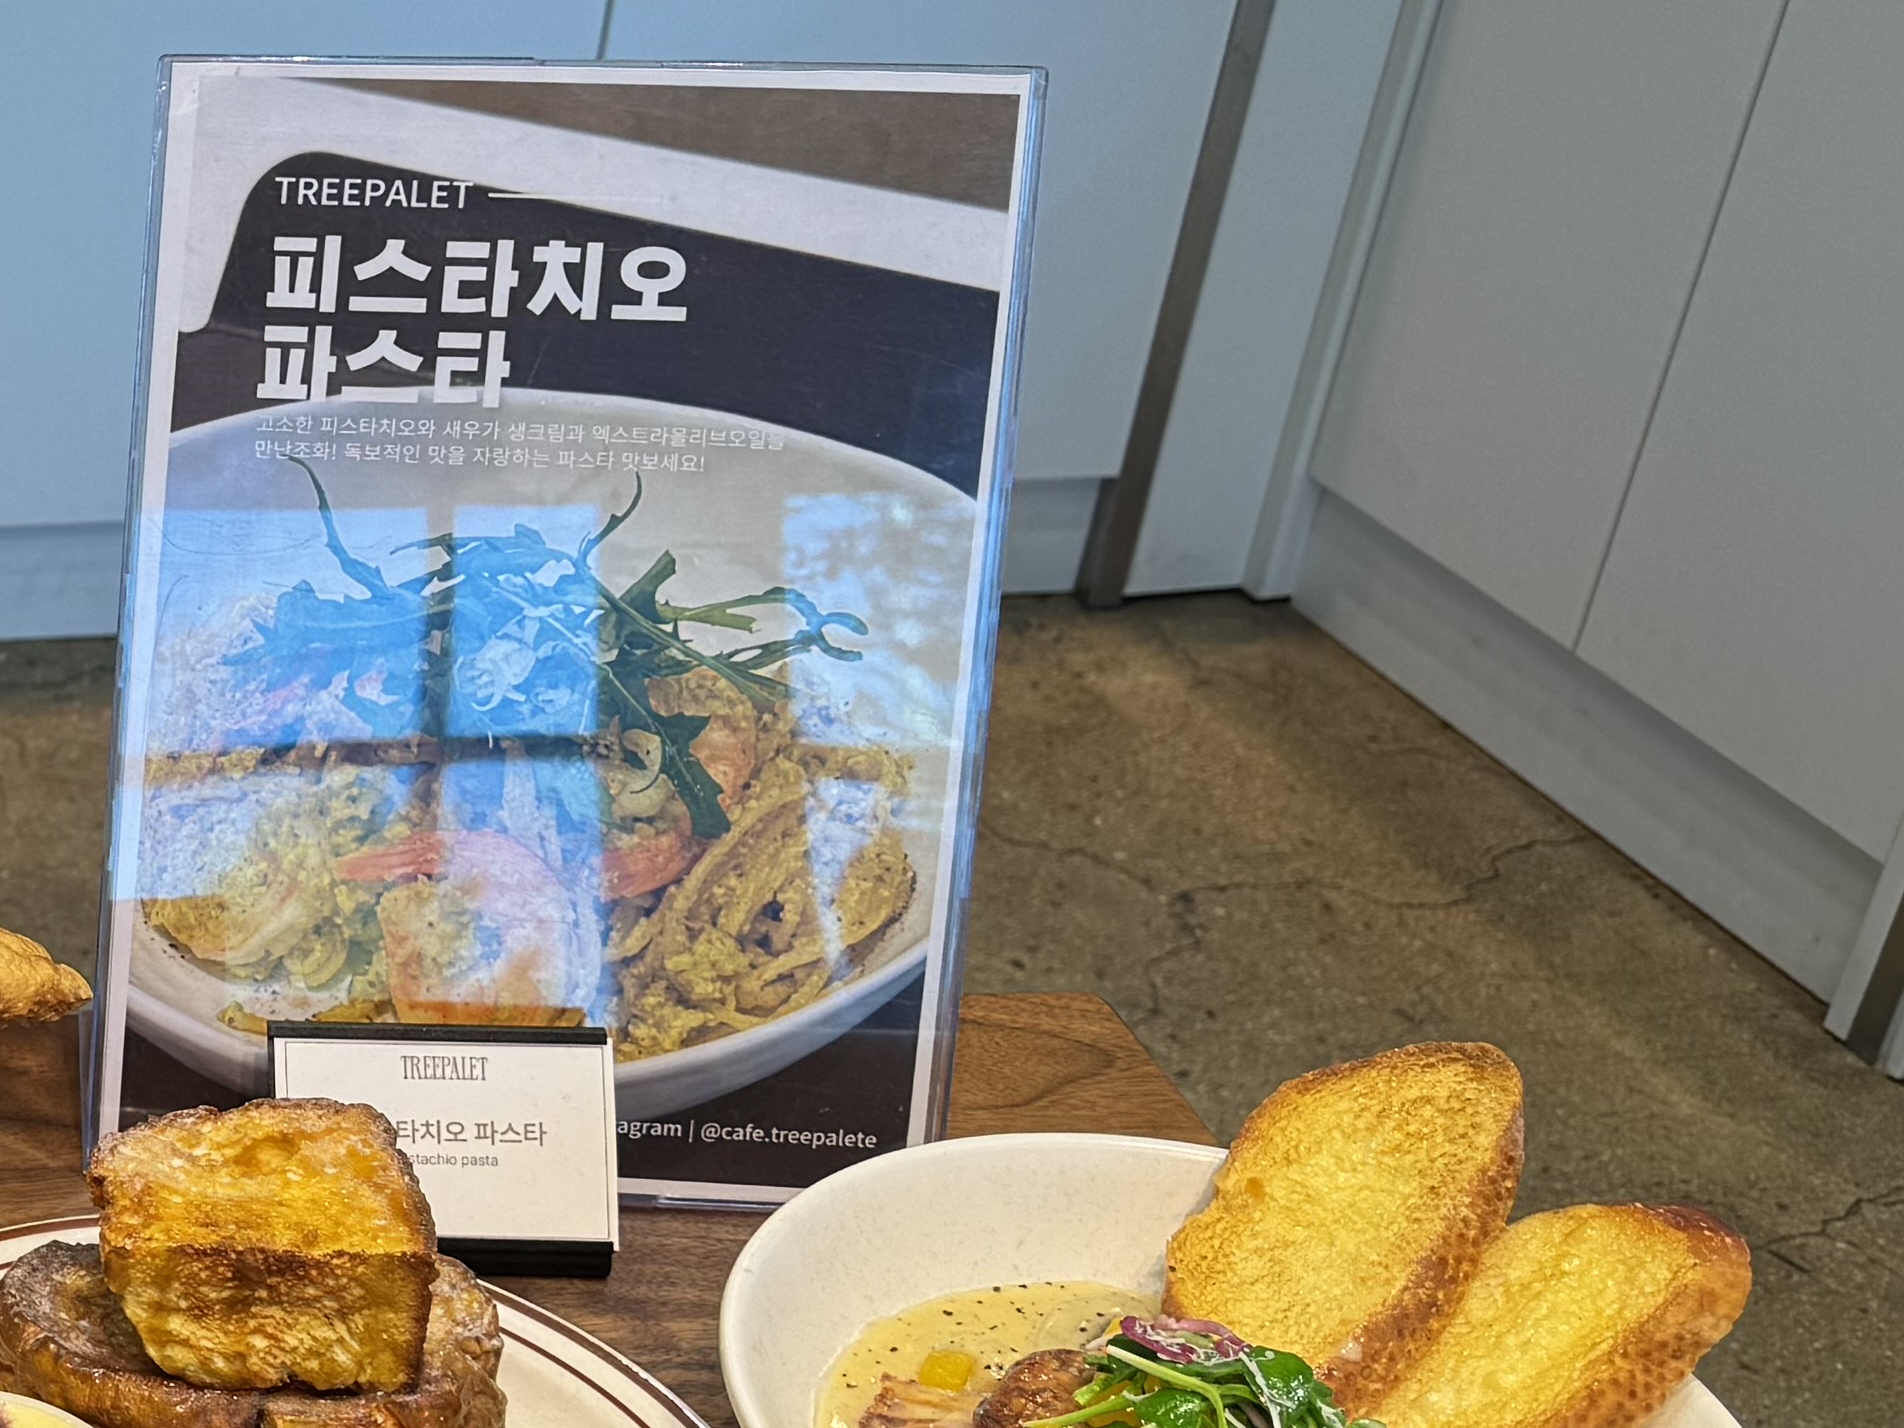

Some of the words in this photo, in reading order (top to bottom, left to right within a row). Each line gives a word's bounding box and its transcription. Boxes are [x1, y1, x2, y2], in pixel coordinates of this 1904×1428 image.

[275, 177, 473, 208] TREEPALET
[265, 235, 687, 322] 피스타치오
[256, 326, 510, 408] 파스타
[255, 416, 317, 435] 고소한
[321, 417, 435, 439] 피스타치오와
[443, 420, 501, 441] 새우가
[508, 422, 585, 444] 생크림과
[344, 441, 421, 464] 독보적인
[428, 444, 466, 465] 맛을
[472, 446, 550, 468] 자랑하는
[556, 448, 613, 470] 파스타
[622, 450, 705, 472] 맛보세요!
[400, 1056, 488, 1080] TREEPALET
[474, 1120, 547, 1146] 파스타
[701, 1122, 878, 1149] @cafe.treepalete
[461, 1155, 499, 1168] pasta
